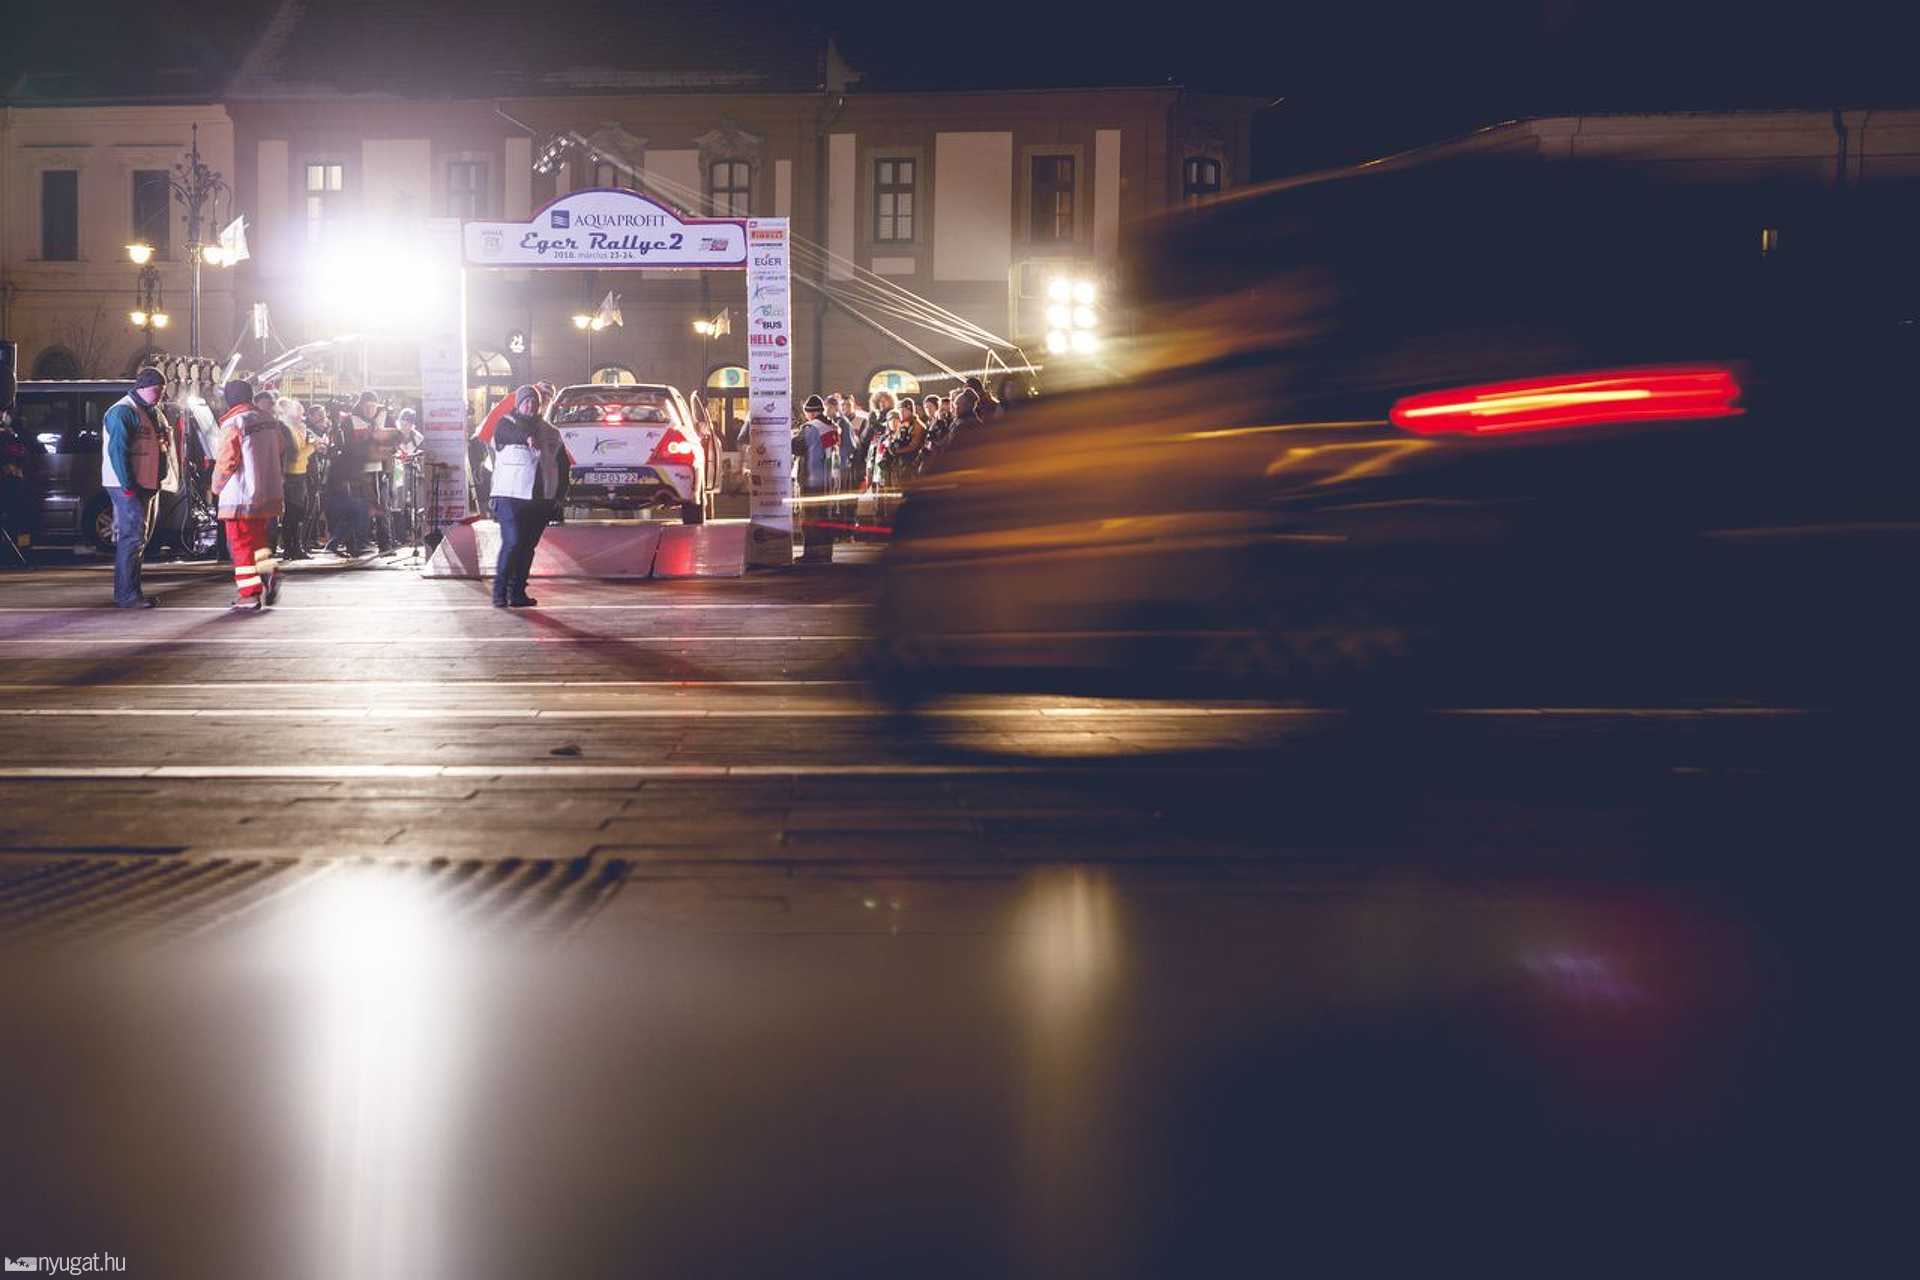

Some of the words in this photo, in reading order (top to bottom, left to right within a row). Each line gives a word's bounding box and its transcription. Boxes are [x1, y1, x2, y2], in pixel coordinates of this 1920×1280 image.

[574, 214, 668, 229] AQUAPROFIT
[520, 232, 579, 255] Eger
[750, 334, 773, 345] HELL
